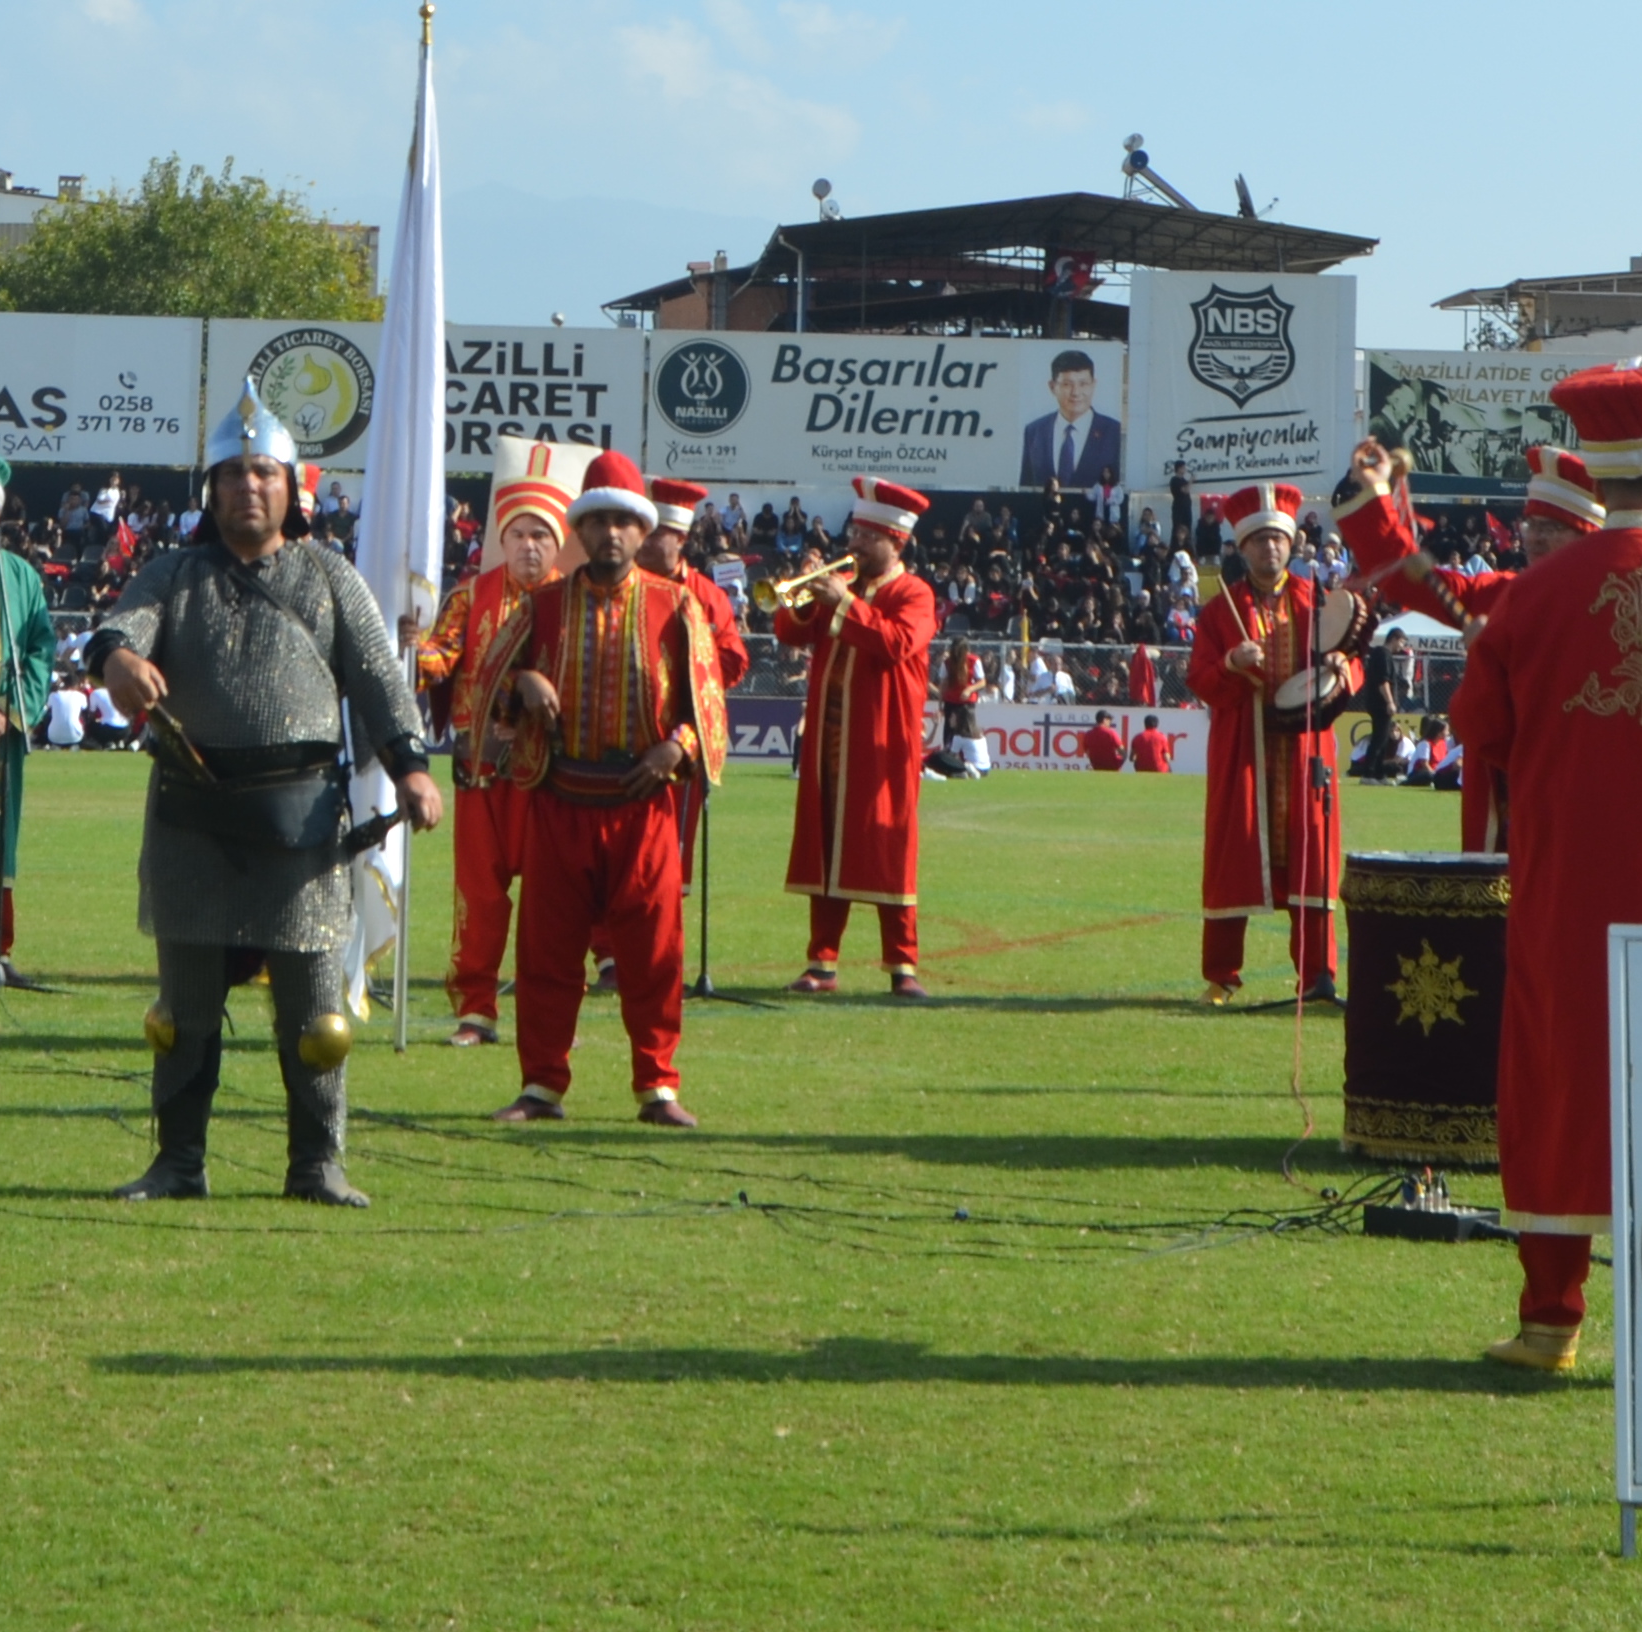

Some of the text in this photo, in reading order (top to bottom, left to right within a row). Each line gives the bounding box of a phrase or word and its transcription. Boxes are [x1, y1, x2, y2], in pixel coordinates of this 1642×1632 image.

[1208, 307, 1277, 335] NBS
[770, 343, 998, 395] Başarılar
[1475, 362, 1532, 382] ATİDE
[342, 346, 375, 415] BORSASI
[98, 395, 154, 412] 0258
[444, 380, 608, 417] CARET
[1447, 384, 1527, 404] VİLAYET
[805, 389, 994, 438] Dilerim.
[76, 415, 180, 435] 371 78 76
[1176, 420, 1320, 460] Şampiyonluk
[681, 444, 737, 457] 444 1 391
[812, 443, 947, 463] Kürşat Engin ÖZCAN
[1418, 637, 1467, 651] NAZİL
